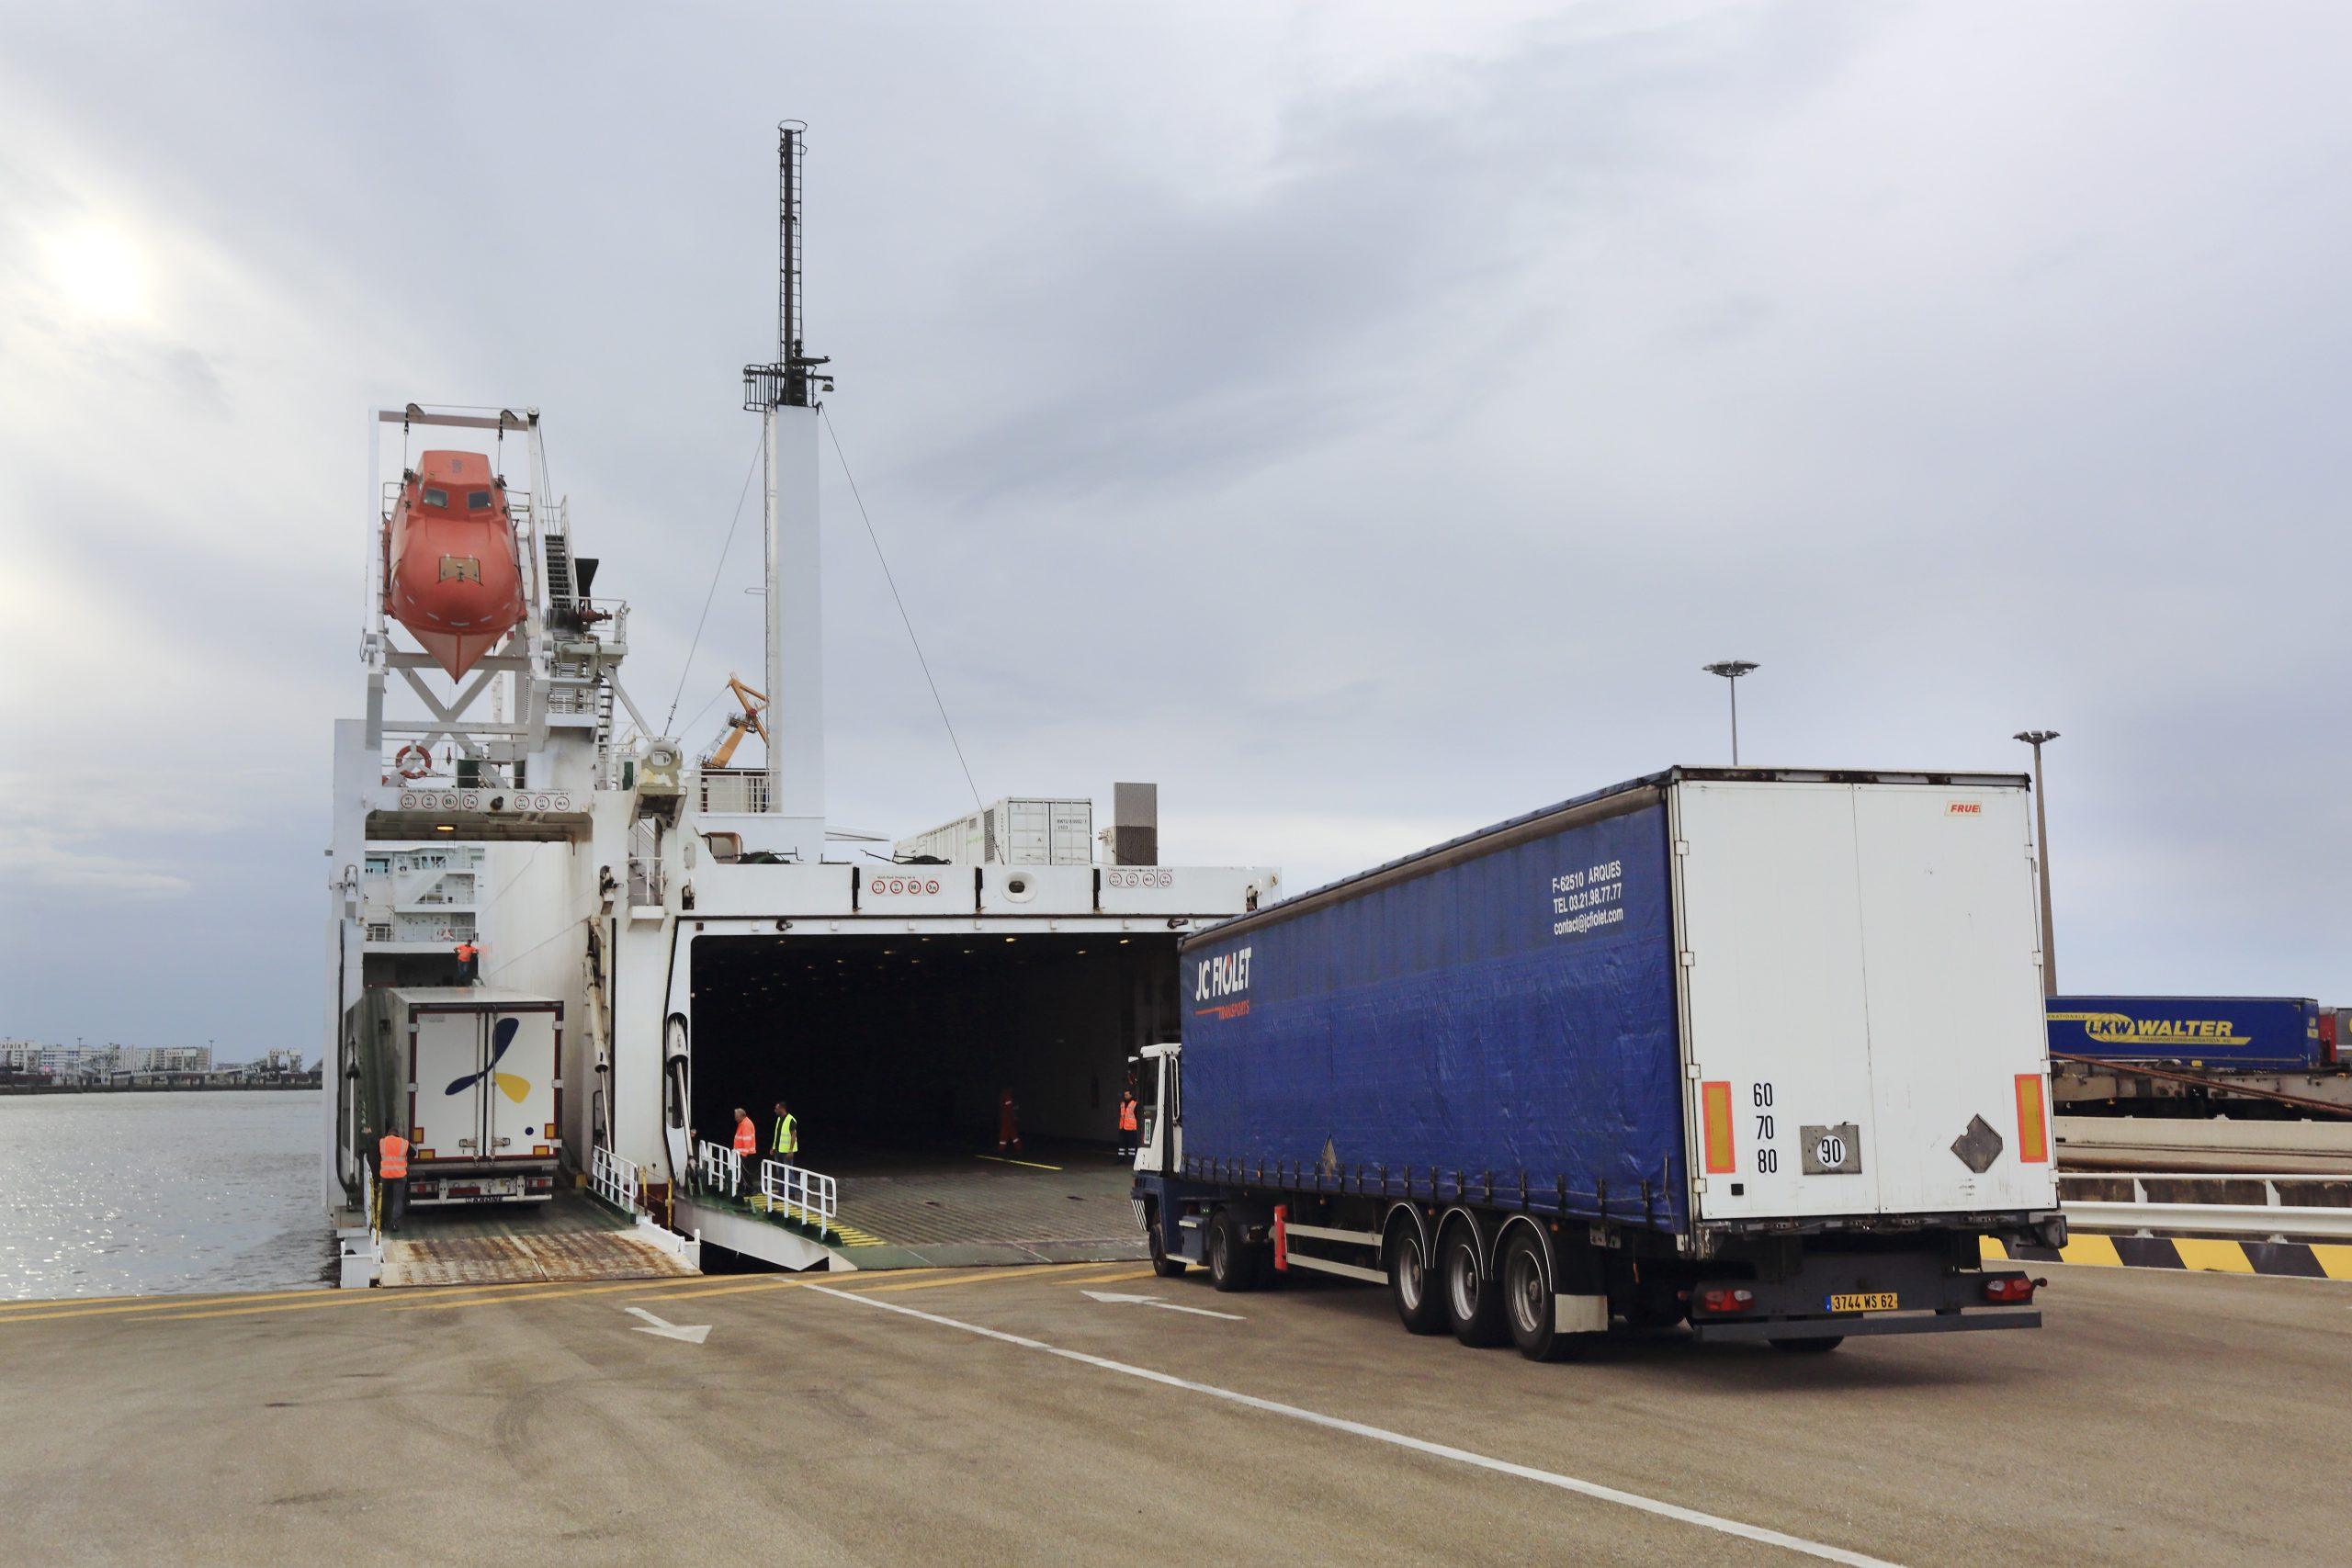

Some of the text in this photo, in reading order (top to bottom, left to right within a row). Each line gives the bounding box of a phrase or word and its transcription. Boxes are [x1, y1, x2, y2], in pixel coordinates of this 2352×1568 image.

[1552, 860, 1622, 894] F-62510 ARQUES
[1553, 882, 1623, 914] TEL 03.21.98.77.77
[1554, 908, 1623, 935] contact@jcfiolet.com
[1195, 946, 1252, 1002] JC FIOLET
[1218, 999, 1250, 1021] TRANSPORTS
[2088, 1020, 2233, 1036] LKW WALTER
[1753, 1082, 1773, 1107] 60
[1756, 1115, 1774, 1140] 70
[1758, 1149, 1778, 1174] 80
[1821, 1138, 1841, 1163] 90
[1835, 1294, 1894, 1310] 3744 WS 62
